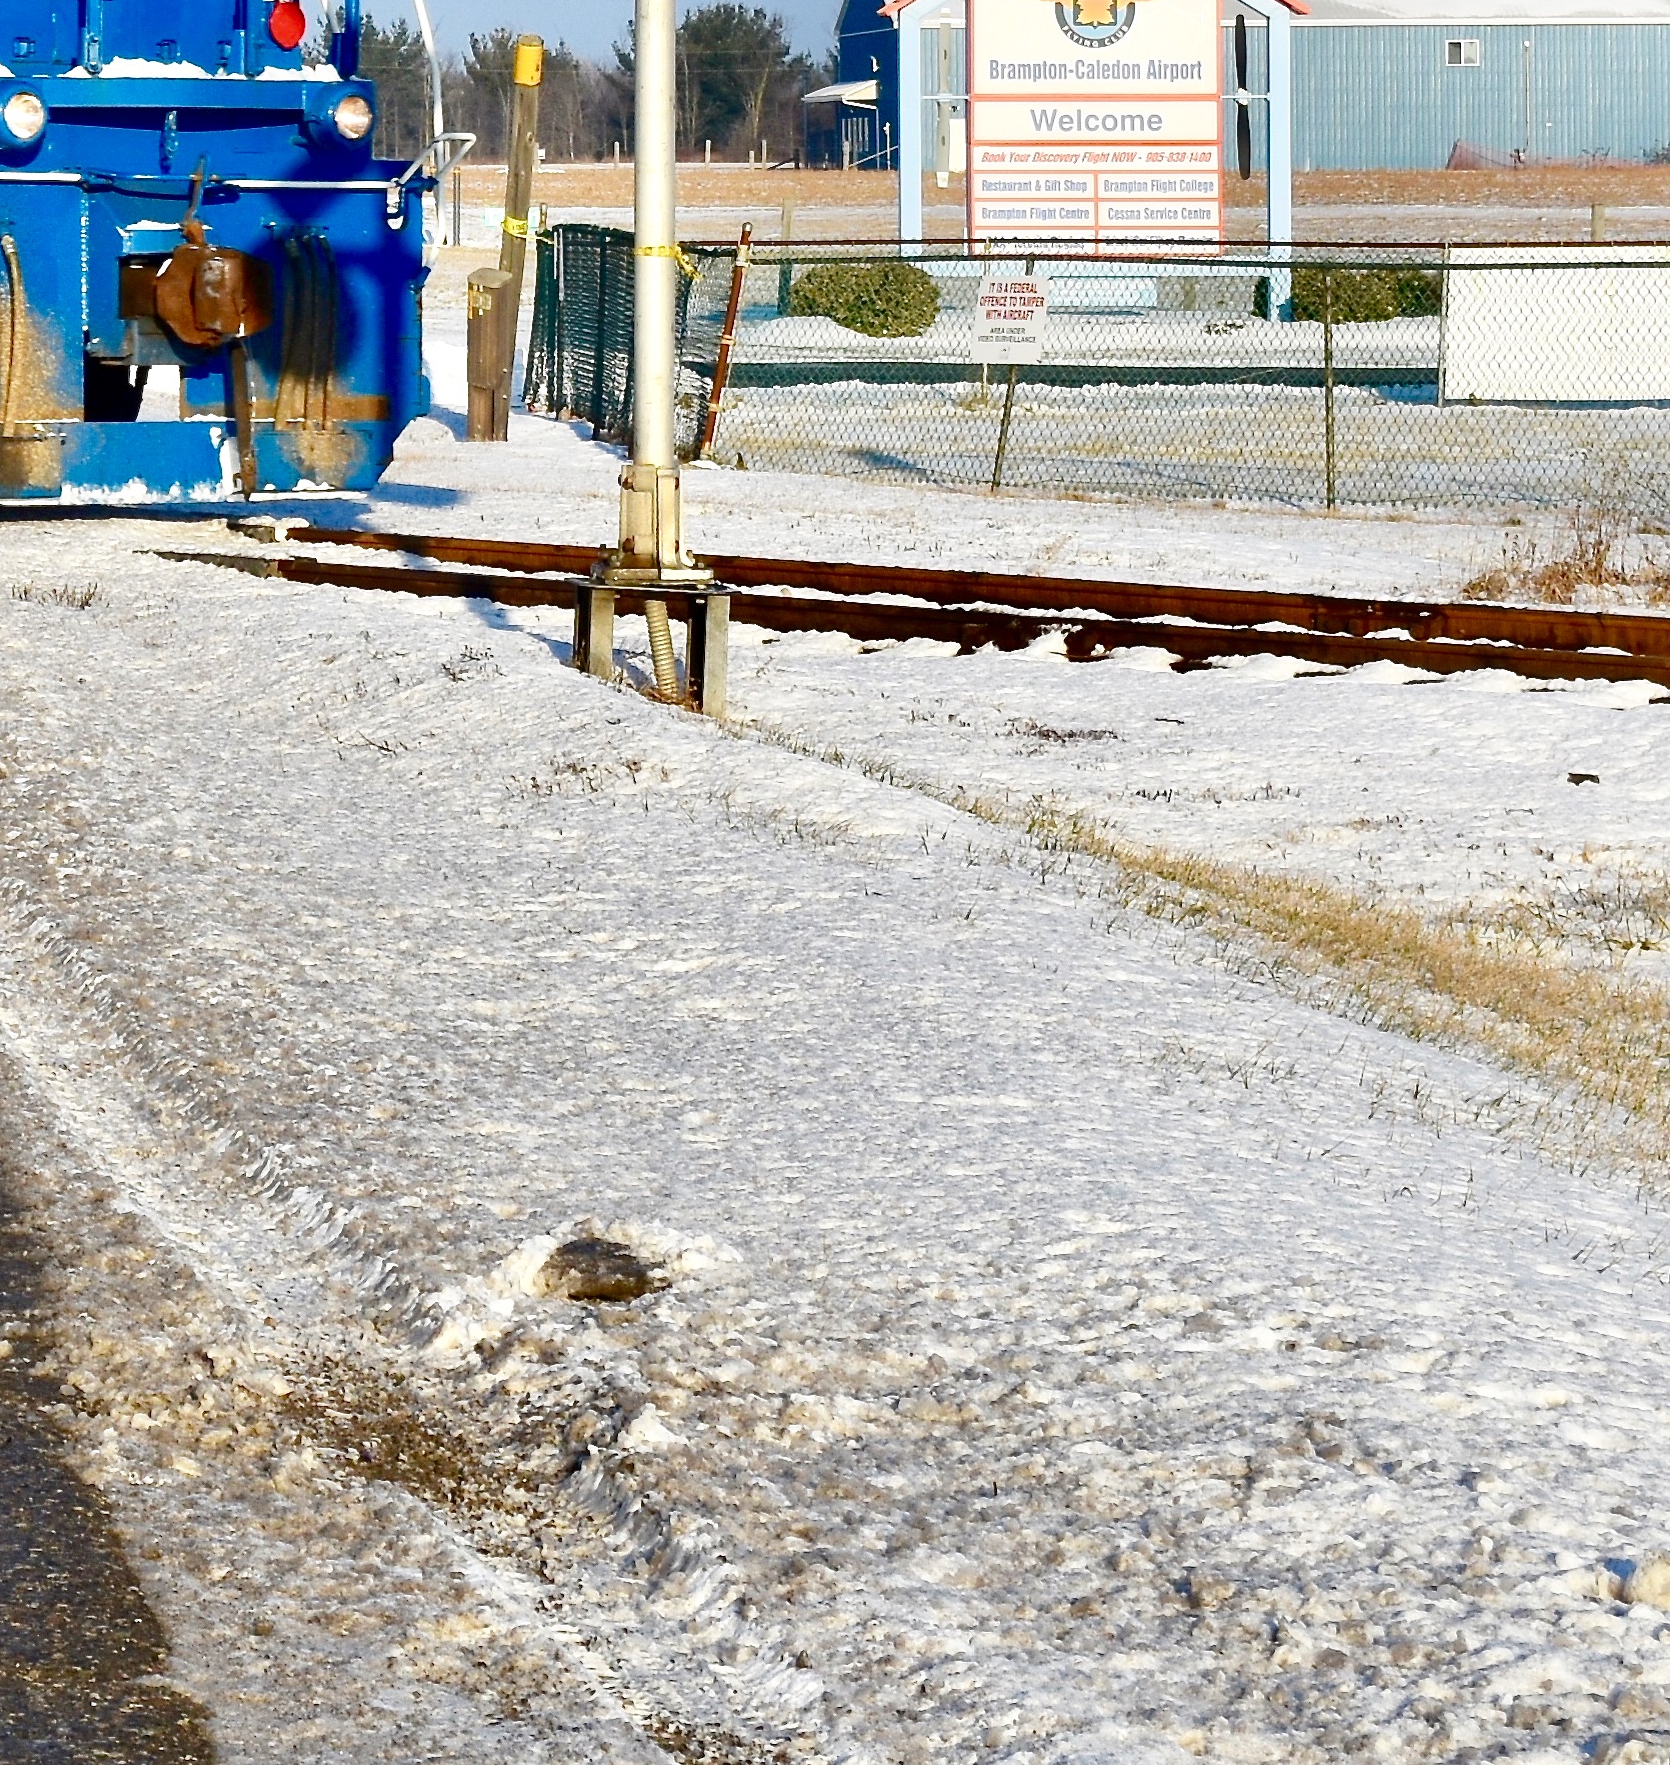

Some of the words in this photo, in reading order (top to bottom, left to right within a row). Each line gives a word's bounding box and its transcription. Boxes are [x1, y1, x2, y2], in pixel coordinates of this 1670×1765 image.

[989, 59, 1141, 82] Brampton-Caledon
[1146, 59, 1202, 82] Airport
[1029, 108, 1163, 132] Welcome
[981, 152, 1006, 163] Book
[1008, 152, 1030, 163] Your
[1032, 152, 1080, 164] Discovery
[1082, 152, 1110, 164] Flight
[1111, 152, 1137, 163] NOW
[981, 179, 1032, 192] Restaurant
[1034, 179, 1042, 192] &
[1044, 179, 1061, 192] Gift
[1064, 179, 1088, 193] Shop
[1103, 179, 1148, 193] Brampton
[1151, 179, 1177, 193] Flight
[1179, 179, 1215, 193] College
[981, 207, 1027, 221] Brampton
[1030, 207, 1056, 221] Flight
[1059, 207, 1090, 220] Centre
[1107, 207, 1141, 220] Cessna
[1144, 207, 1178, 220] Service
[1181, 207, 1212, 220] Centre
[1010, 282, 1038, 294] FEDERAL
[980, 296, 1008, 307] OFFENCE
[1009, 296, 1017, 307] TO
